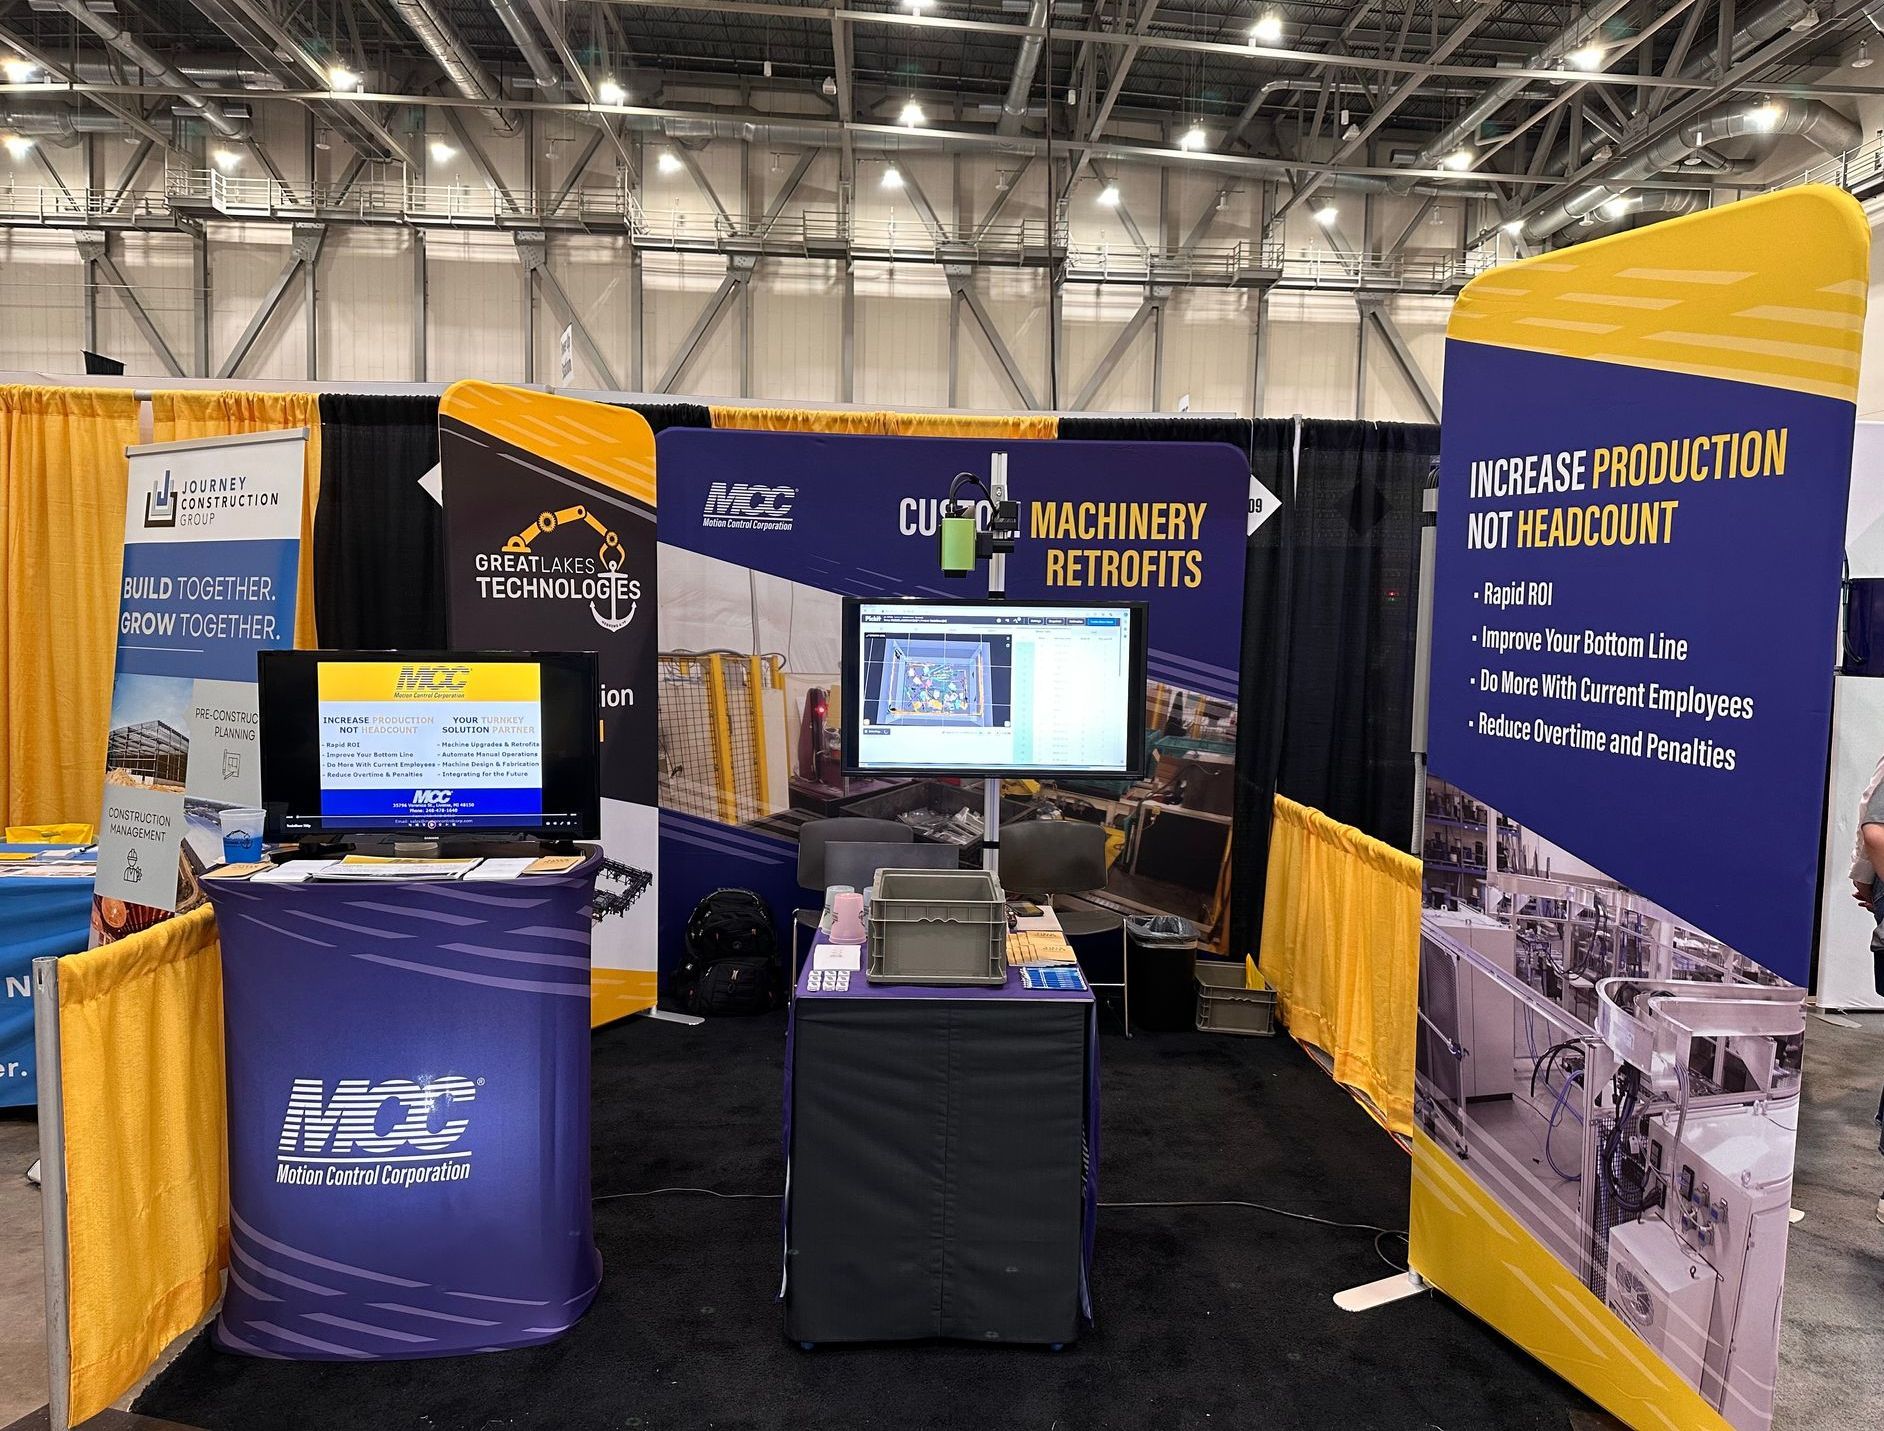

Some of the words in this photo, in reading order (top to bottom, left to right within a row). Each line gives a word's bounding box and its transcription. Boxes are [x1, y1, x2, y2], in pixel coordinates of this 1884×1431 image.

[1469, 450, 1587, 498] INCREASE
[1592, 428, 1788, 490] PRODUCTION
[181, 476, 247, 494] JOURNEY
[181, 493, 279, 510] CONSTRUCTION
[179, 512, 216, 527] GROUP
[702, 517, 727, 528] Motion
[727, 519, 753, 529] Control
[752, 520, 793, 532] Corporation
[1030, 501, 1208, 540] MACHINERY
[1467, 510, 1513, 550] NOT
[1517, 500, 1679, 549] HEADCOUNT
[1046, 549, 1203, 588] RETROFITS
[123, 577, 173, 599] BUILD
[177, 576, 276, 601] TOGETHER.
[476, 576, 641, 600] TECHNOLOGIES
[1484, 581, 1525, 610] Rapid
[1528, 582, 1553, 606] ROI
[120, 611, 176, 635] GROW
[180, 613, 281, 640] TOGETHER.
[1481, 625, 1542, 654] Improve
[1545, 628, 1581, 654] Your
[1583, 629, 1644, 658] Bottom
[1648, 632, 1688, 661] Line
[1480, 668, 1498, 692] Do
[1501, 670, 1538, 697] More
[1541, 673, 1577, 701] With
[1580, 677, 1645, 708] Current
[1648, 683, 1754, 721] Employees
[323, 716, 369, 724] INCREASE
[372, 716, 434, 724] PRODUCTION
[340, 726, 358, 734] NOT
[361, 726, 418, 734] HEADCOUNT
[442, 726, 490, 734] SOLUTION
[492, 726, 535, 734] PARTNER
[453, 716, 479, 724] YOUR
[480, 716, 524, 724] TURNKEY
[214, 726, 256, 742] PLANNING
[1478, 711, 1531, 741] Reduce
[1533, 718, 1606, 752] Overtime
[1610, 731, 1643, 757] and
[1646, 733, 1736, 771] Penalties
[412, 789, 452, 804] MCC
[108, 807, 171, 827] CONSTRUCTION
[109, 823, 167, 842] MANAGEMENT
[276, 1163, 323, 1186] Motion
[326, 1165, 380, 1186] Control
[381, 1160, 470, 1188] Corporation
